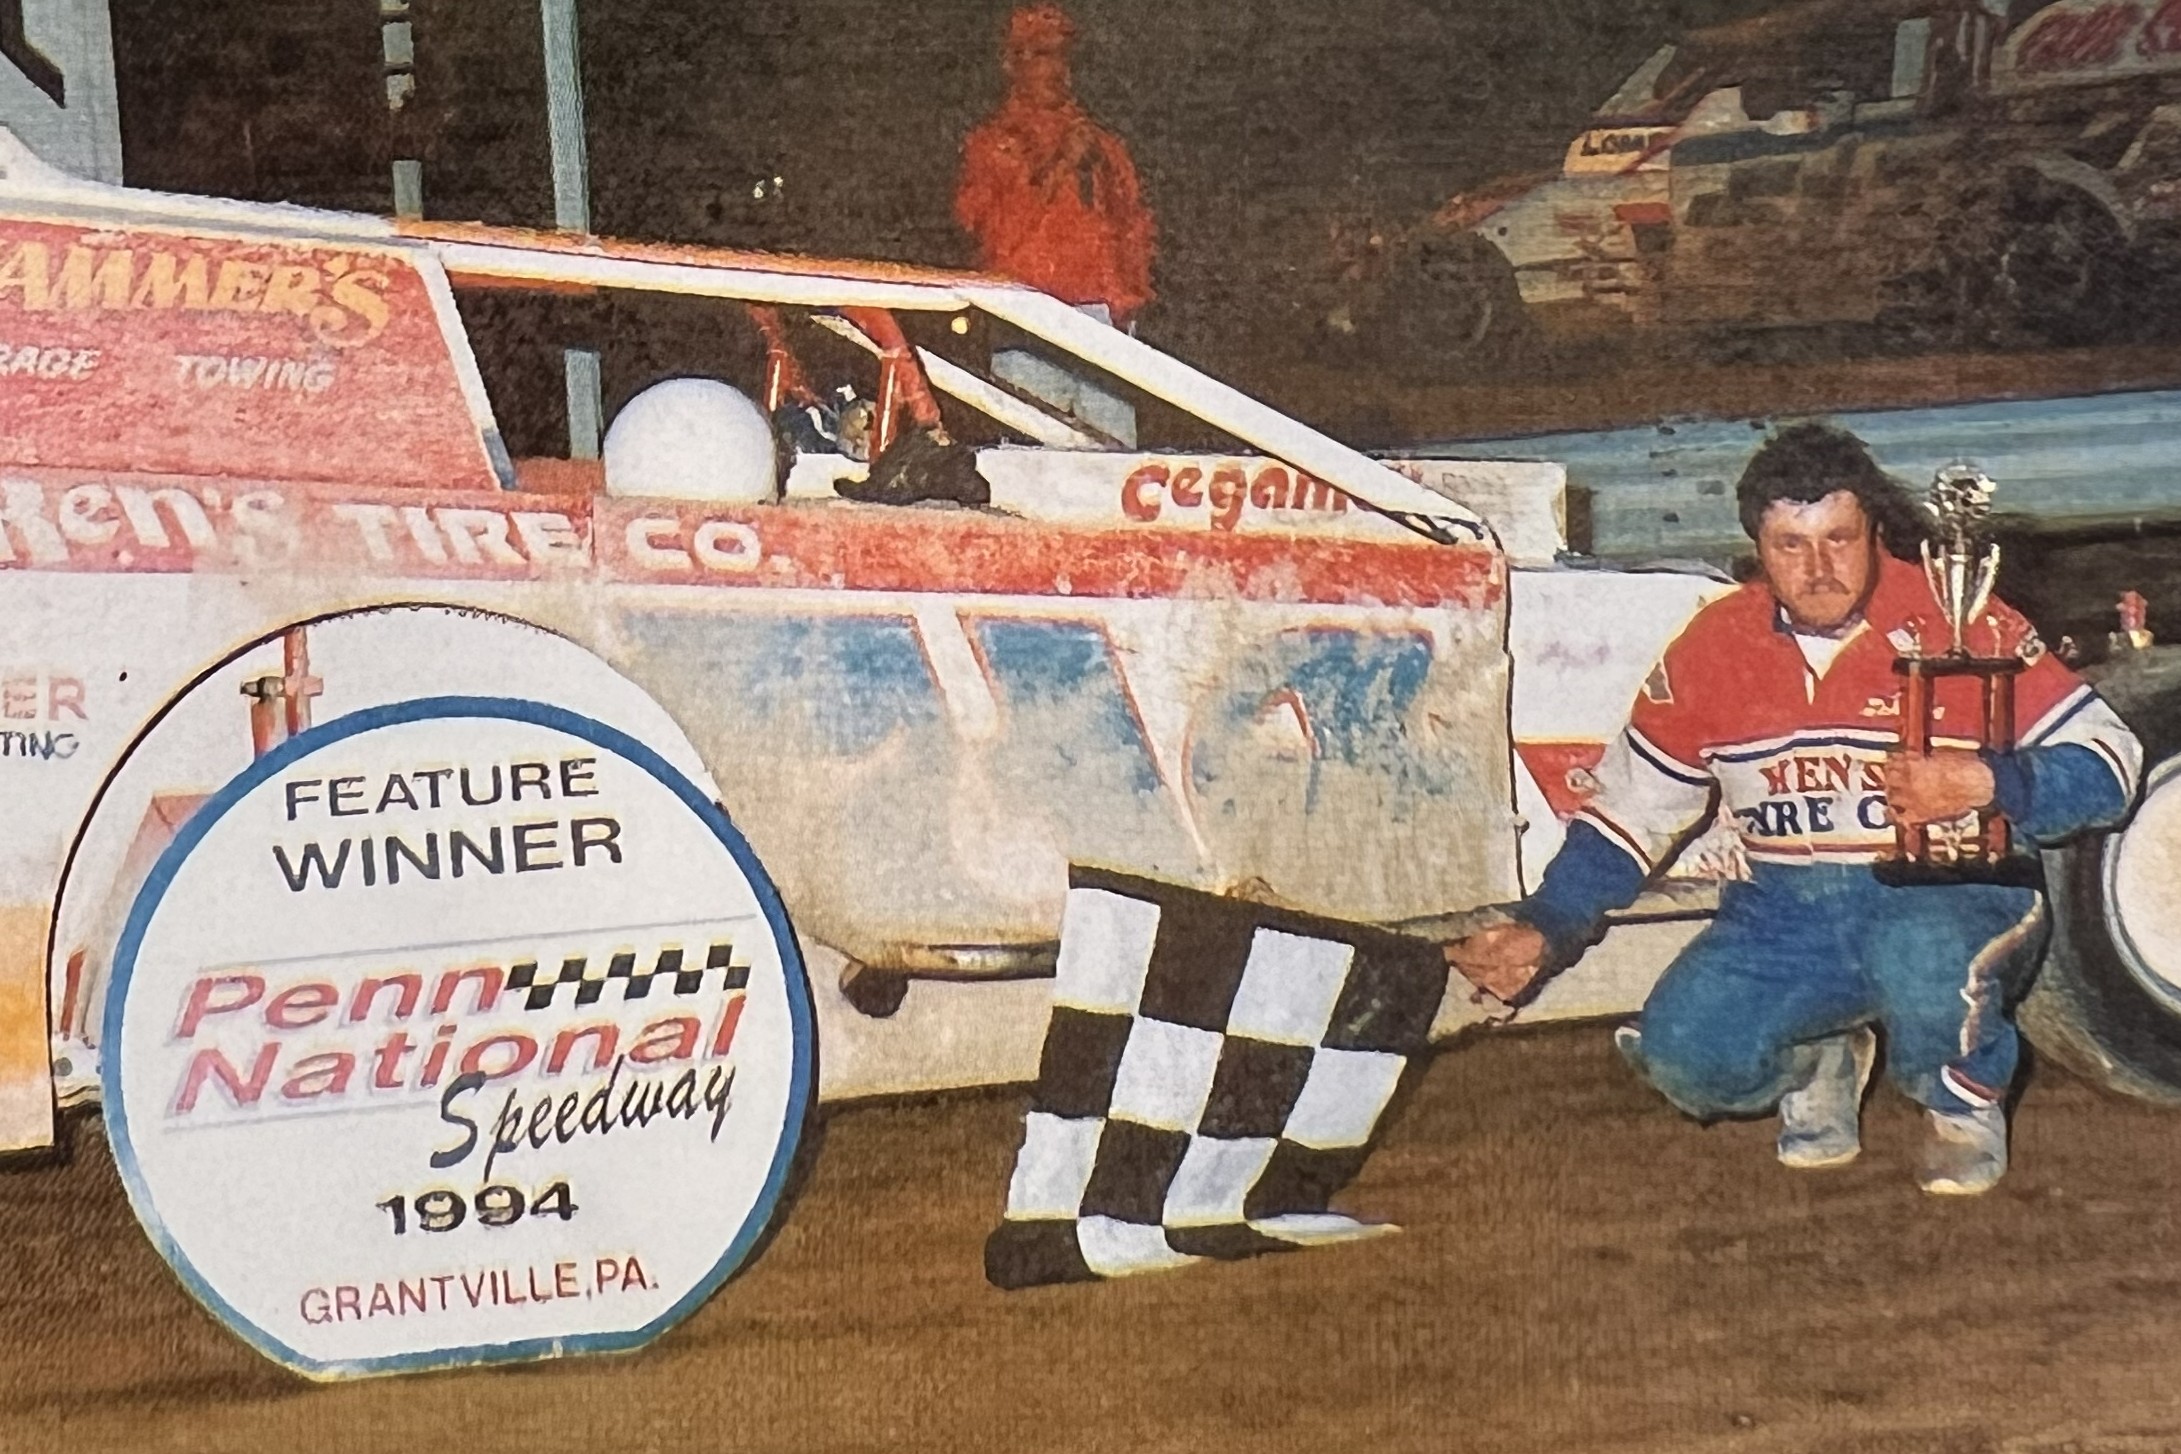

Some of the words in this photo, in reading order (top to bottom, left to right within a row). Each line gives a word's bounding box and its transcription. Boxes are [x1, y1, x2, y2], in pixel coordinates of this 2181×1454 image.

[175, 354, 338, 393] TOWING
[331, 503, 590, 568] TIRE
[285, 757, 599, 821] FEATURE
[273, 817, 622, 892] WINNER
[170, 965, 504, 1040] Penn
[172, 995, 746, 1116] National
[430, 1053, 736, 1183] Speedway
[376, 1181, 579, 1236] 1994
